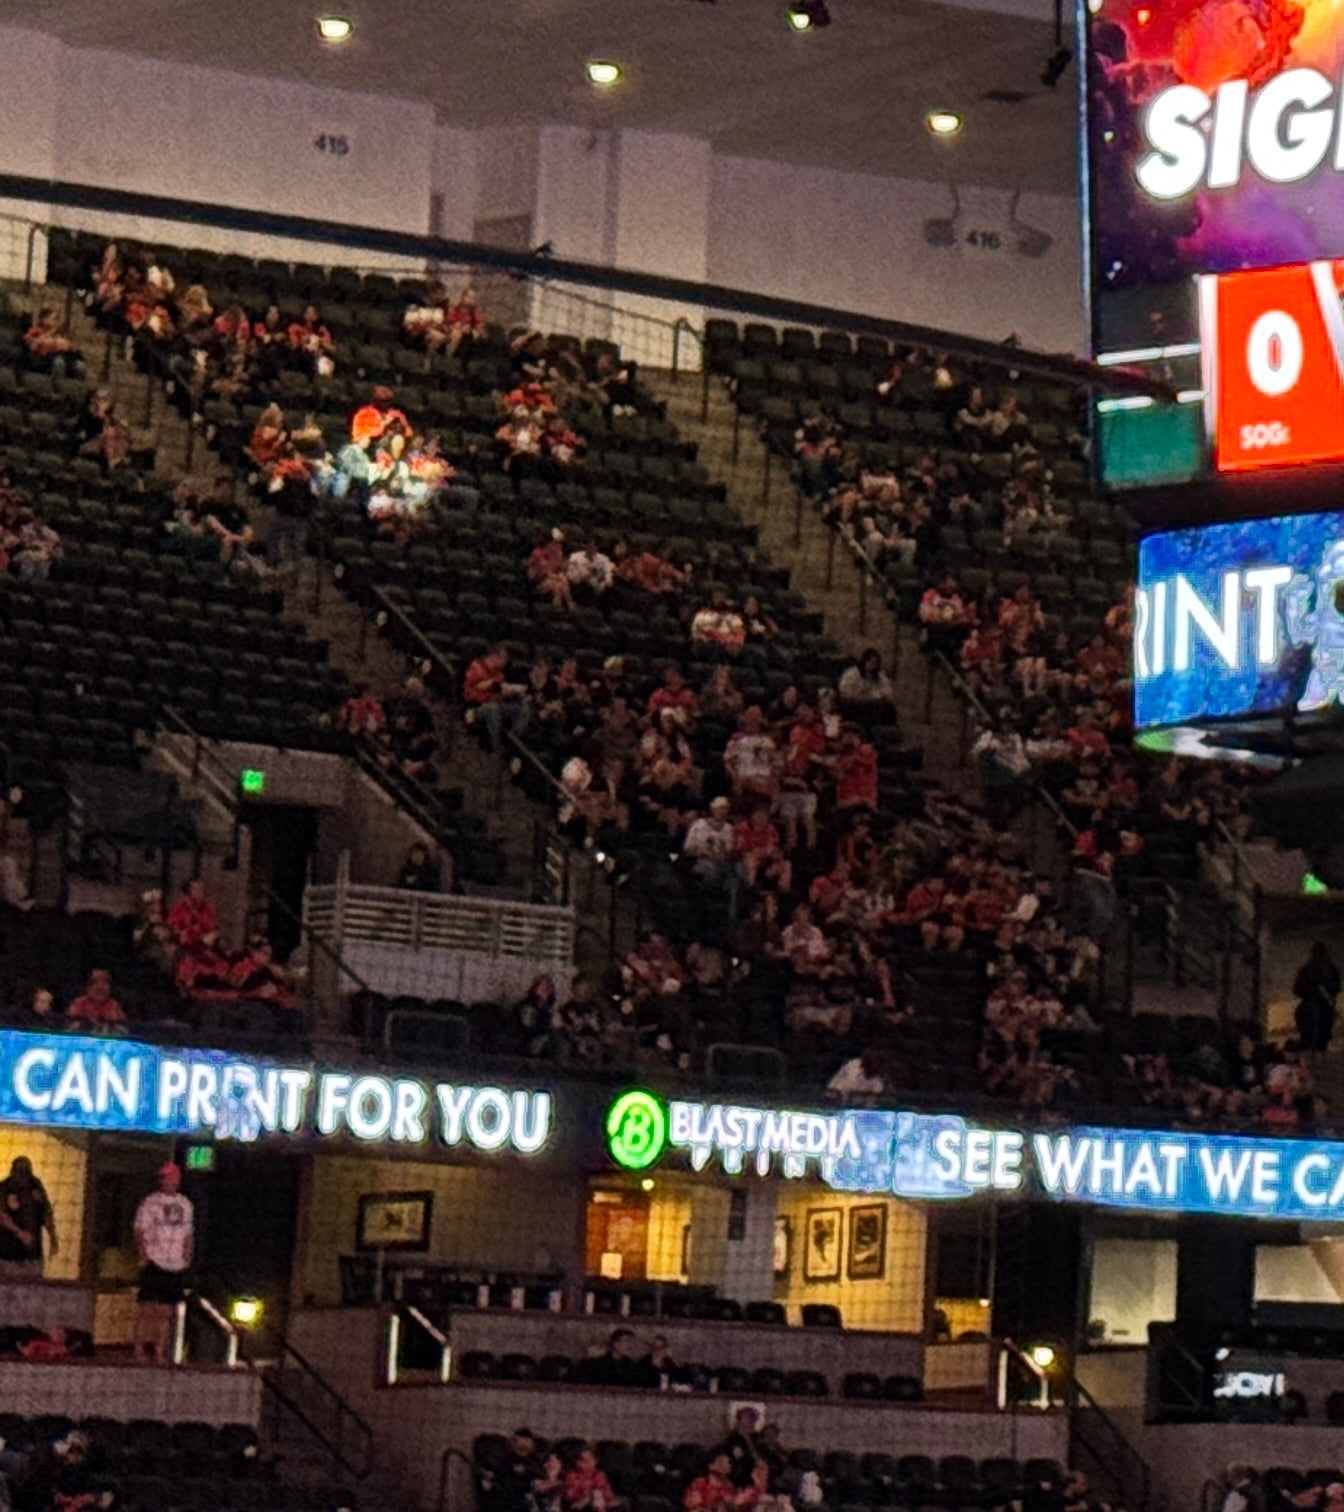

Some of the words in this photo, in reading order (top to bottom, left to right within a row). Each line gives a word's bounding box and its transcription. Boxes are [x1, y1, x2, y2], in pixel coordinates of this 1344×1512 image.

[1247, 309, 1304, 396] 0
[13, 1047, 140, 1120] CAN
[319, 1074, 425, 1142] FOR
[437, 1085, 552, 1152] YOU
[670, 1102, 762, 1147] BLAST
[762, 1111, 861, 1158] MEDIA
[933, 1131, 1024, 1188] SEE
[1035, 1135, 1185, 1196] WHAT
[1201, 1150, 1280, 1207] WE
